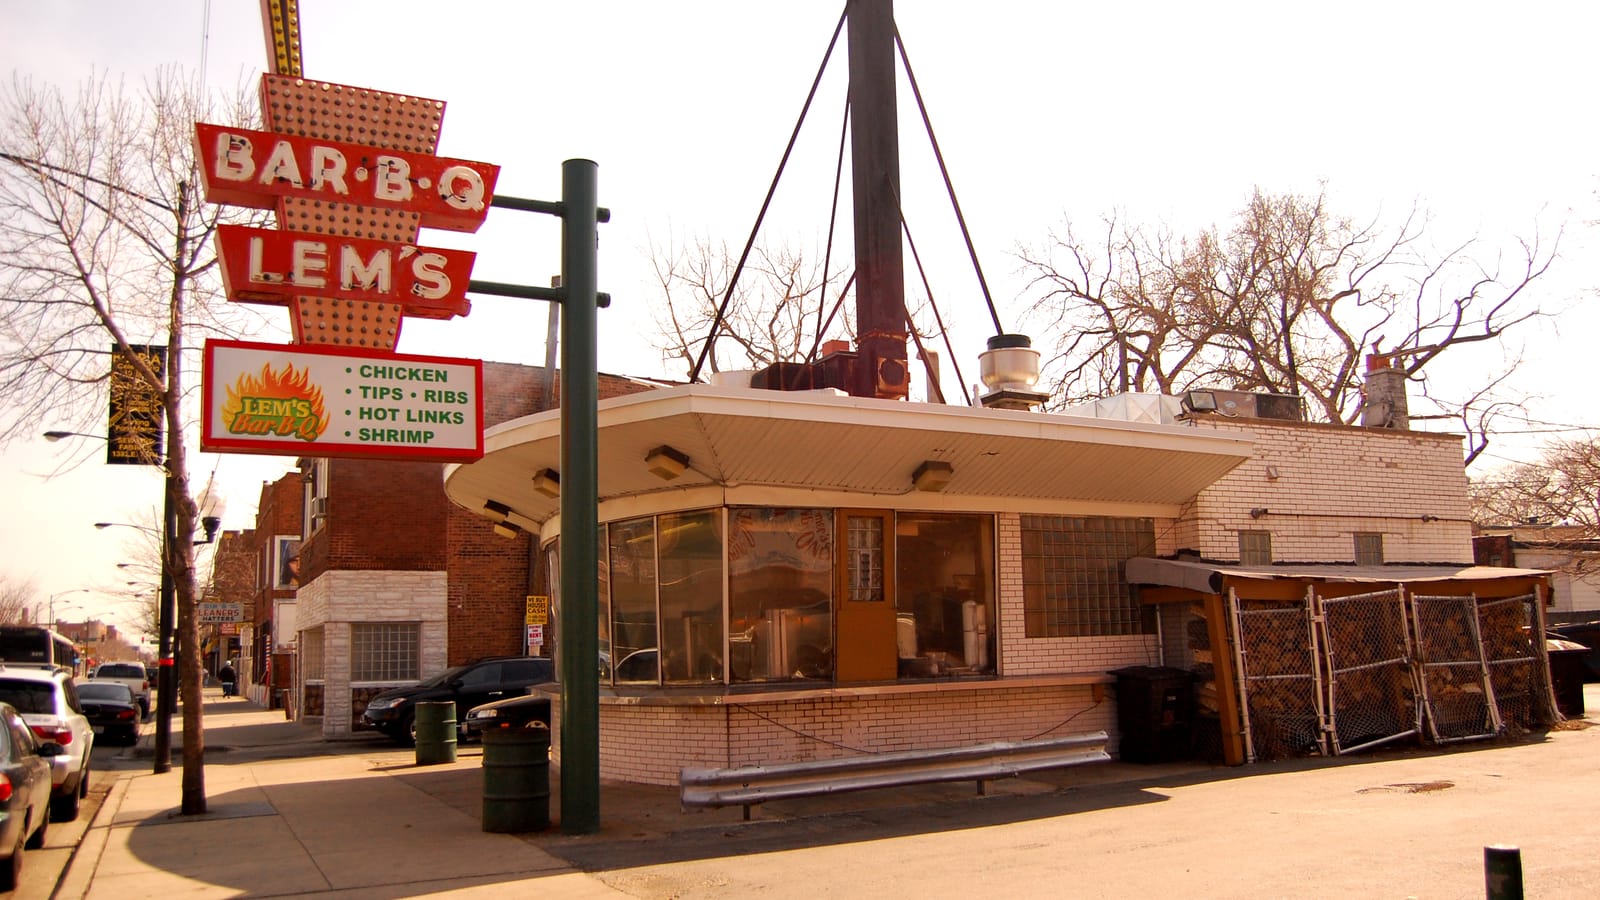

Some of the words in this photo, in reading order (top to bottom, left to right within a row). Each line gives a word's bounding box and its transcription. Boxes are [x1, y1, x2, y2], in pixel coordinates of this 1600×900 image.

[249, 236, 452, 300] LEM'S
[359, 364, 448, 383] CHICKEN
[358, 385, 404, 401] TIPS
[423, 387, 469, 405] RIBS
[242, 398, 311, 418] LEM'S
[358, 406, 400, 423] HOT
[406, 407, 465, 425] LINKS
[358, 427, 435, 444] SHRIMP
